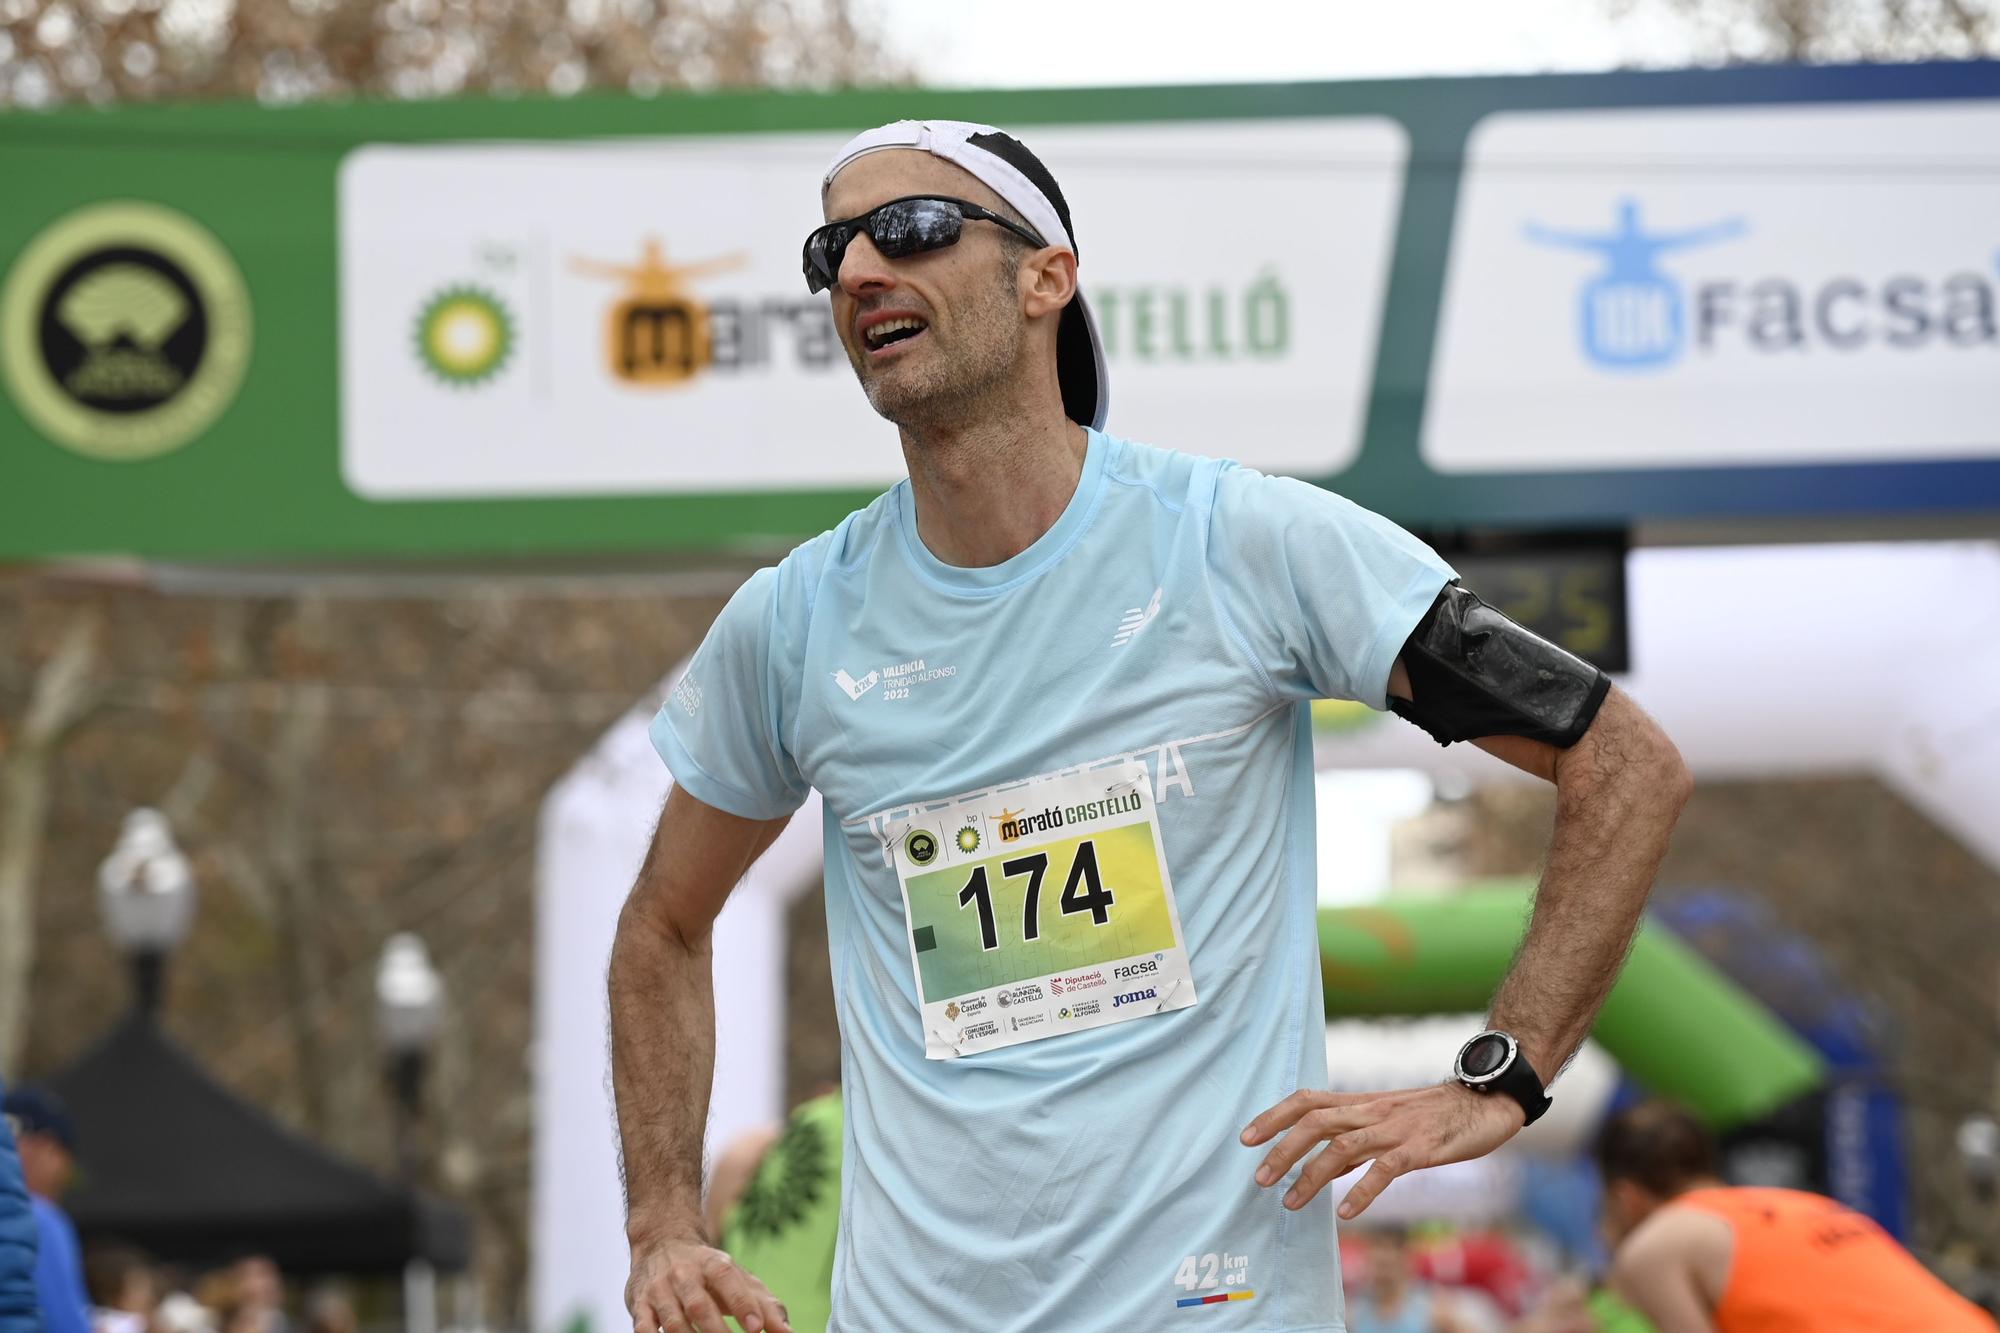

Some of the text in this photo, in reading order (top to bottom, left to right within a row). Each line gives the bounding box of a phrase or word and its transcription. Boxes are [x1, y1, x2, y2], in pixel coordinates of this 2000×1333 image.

[1696, 271, 1998, 350] Facsa
[622, 268, 1291, 372] mara TELLÓ
[882, 659, 925, 678] VALENCIA
[854, 676, 873, 694] 42K
[883, 666, 956, 689] TRINIDAD ALFONSO
[883, 688, 910, 700] 2022
[966, 814, 978, 825] bp
[1001, 789, 1142, 841] marató CASTELLÓ
[957, 839, 1114, 952] 174
[1113, 960, 1158, 979] Facsa
[1065, 971, 1102, 986] Diputació
[1076, 978, 1107, 991] Castelló
[1012, 986, 1042, 998] RUNNING
[961, 1000, 987, 1013] Castelló
[1073, 1003, 1100, 1013] TRINIDAD
[1074, 1008, 1101, 1018] ALFONSO
[964, 1023, 995, 1036] COMUNITAT
[975, 1028, 999, 1039] L'ESPORT
[1174, 1252, 1249, 1291] 42 km
[1225, 1267, 1246, 1286] ed
